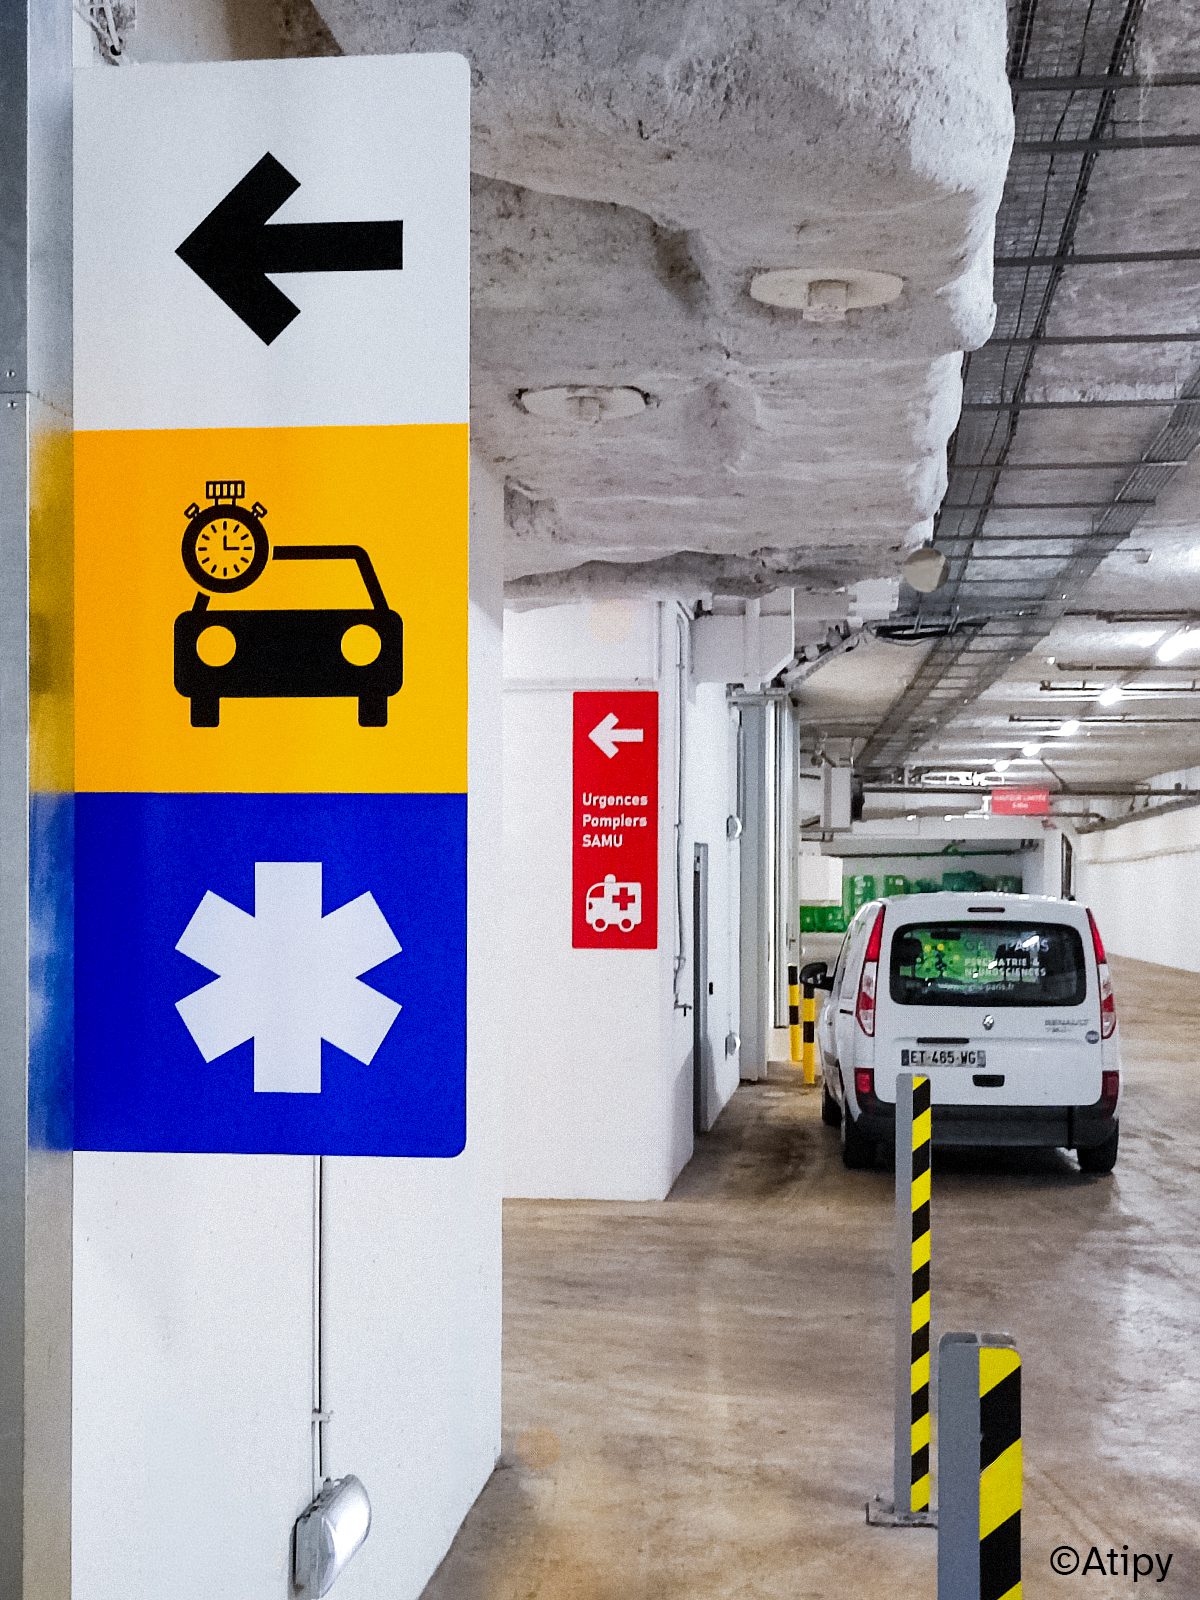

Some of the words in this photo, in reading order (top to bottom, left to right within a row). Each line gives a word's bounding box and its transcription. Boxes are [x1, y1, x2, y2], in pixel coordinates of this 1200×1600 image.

[582, 792, 648, 809] Urgences
[582, 813, 647, 830] Pompiers
[582, 833, 623, 848] SAMU
